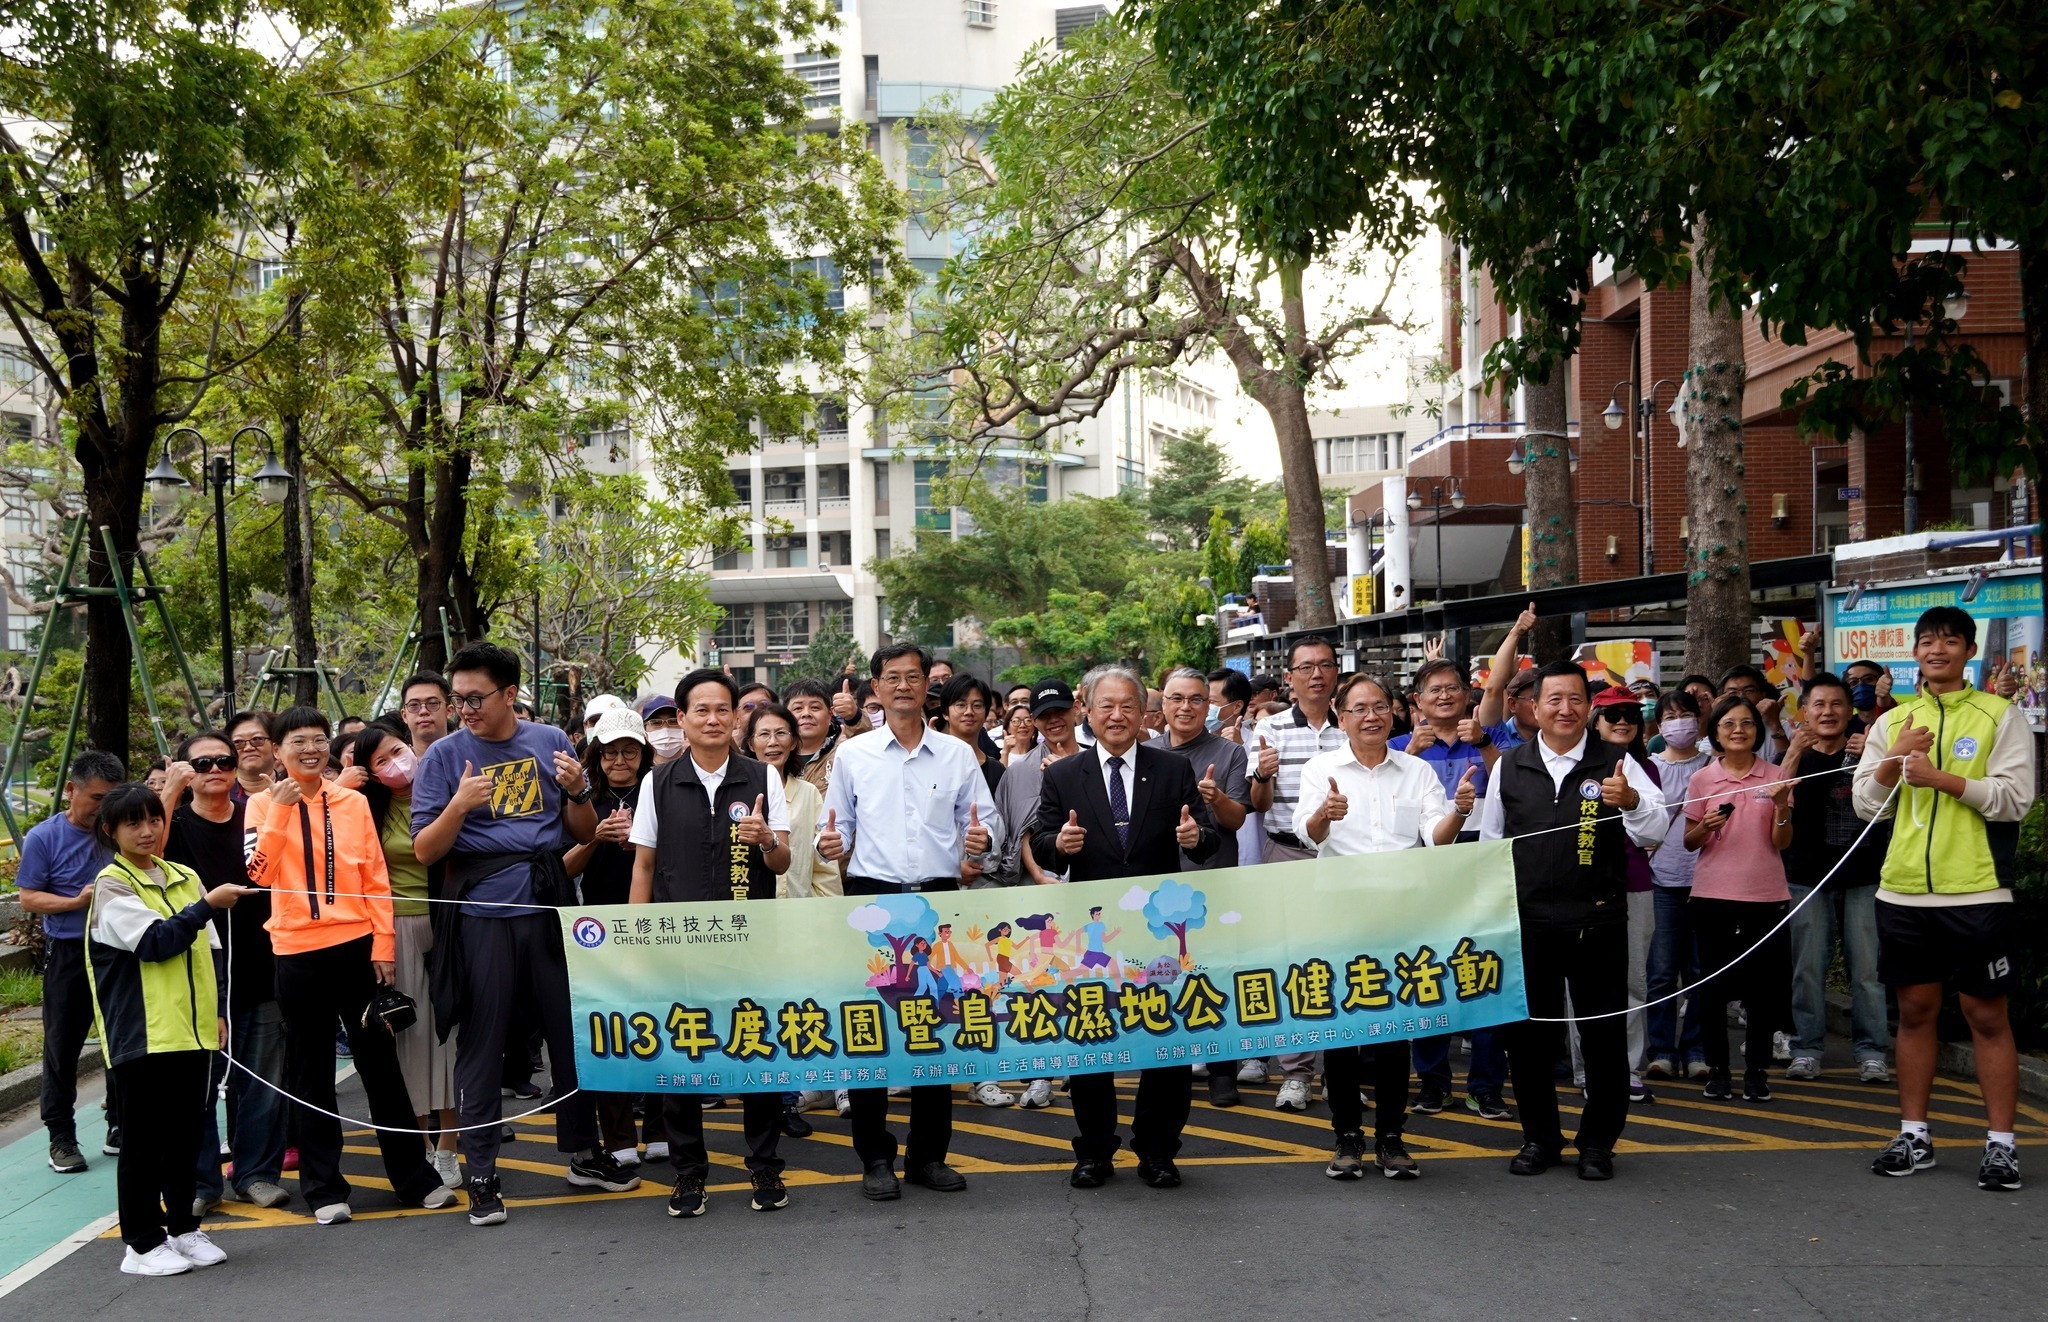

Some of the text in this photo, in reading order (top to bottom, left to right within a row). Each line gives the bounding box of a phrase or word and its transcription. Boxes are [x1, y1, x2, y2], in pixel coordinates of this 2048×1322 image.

[1840, 630, 1869, 660] USR
[1870, 651, 1894, 660] Sustainable
[1577, 799, 1599, 866] 校安教官
[611, 914, 748, 935] 正修科技大學
[613, 932, 750, 946] CHENG SHIU UNIVERSITY
[1987, 955, 2010, 980] 19
[591, 938, 1502, 1060] 113年度校園暨鳥松濕地公園健走活動
